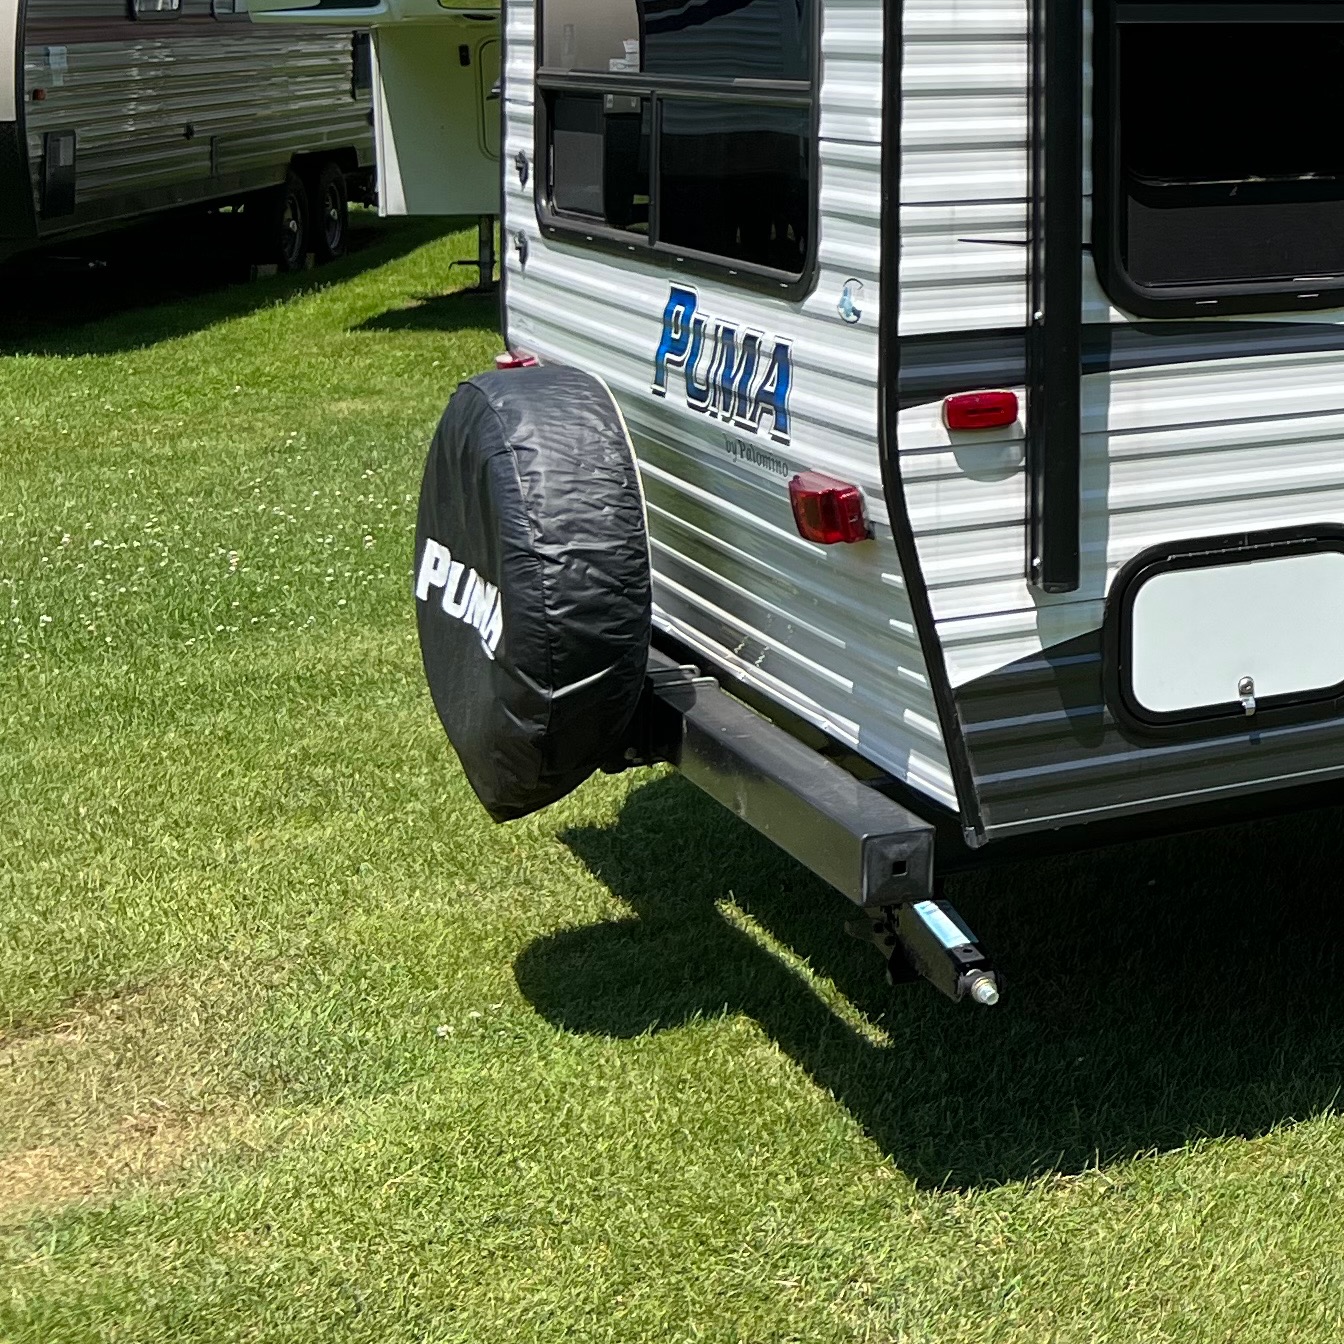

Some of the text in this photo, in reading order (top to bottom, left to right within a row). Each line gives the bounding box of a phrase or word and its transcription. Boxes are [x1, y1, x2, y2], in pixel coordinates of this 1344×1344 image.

[650, 280, 794, 447] PUMA
[723, 433, 789, 478] by Palomino
[416, 537, 503, 660] PUMA
